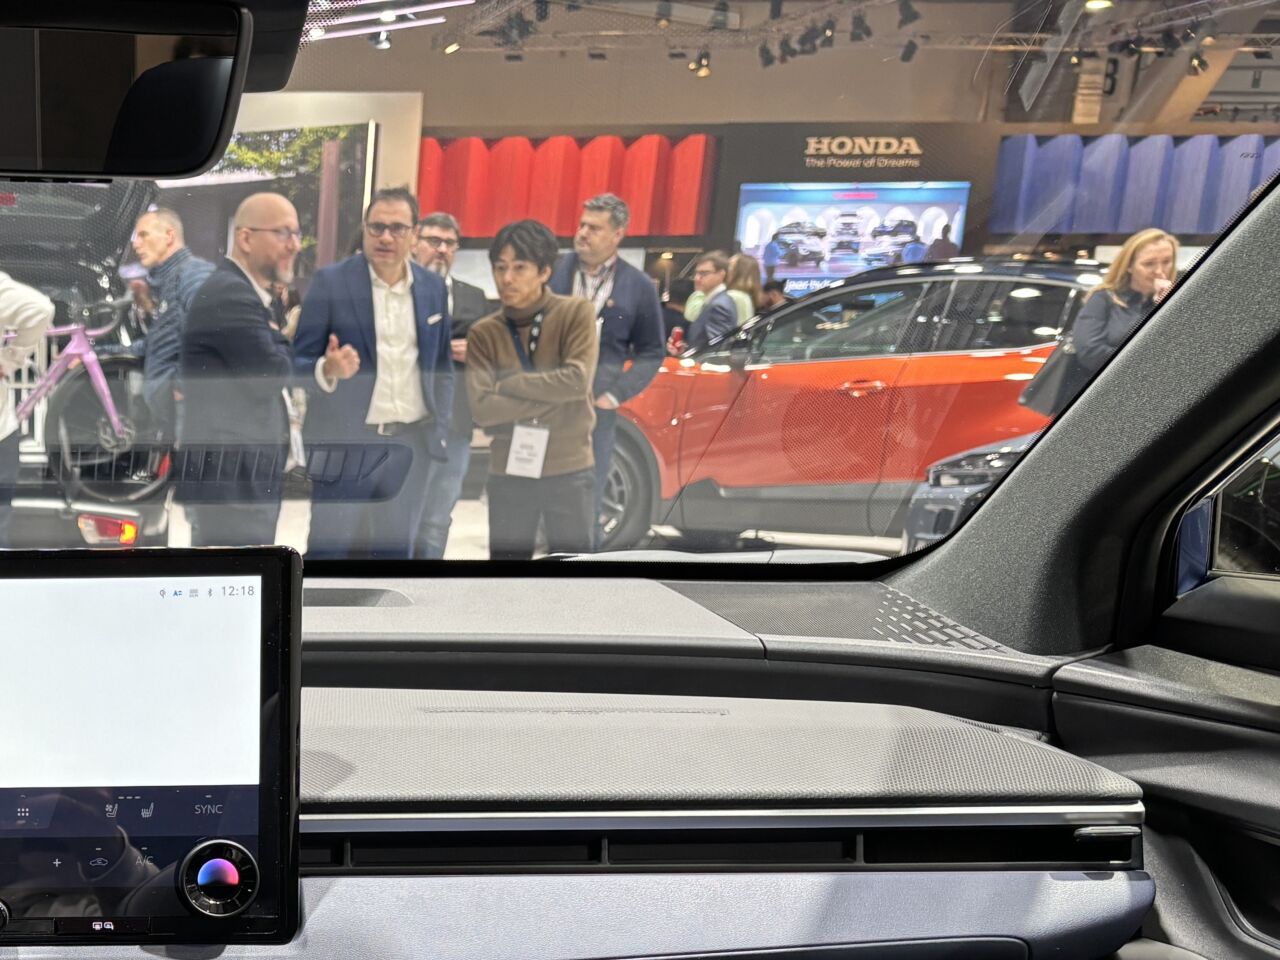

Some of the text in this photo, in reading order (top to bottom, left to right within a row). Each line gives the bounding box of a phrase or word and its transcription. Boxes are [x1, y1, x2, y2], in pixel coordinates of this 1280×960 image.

[804, 136, 923, 155] HONDA
[805, 157, 920, 168] The Power of Dreams
[221, 586, 255, 596] 12:18
[194, 804, 223, 815] SYNC
[135, 855, 154, 866] A/C
